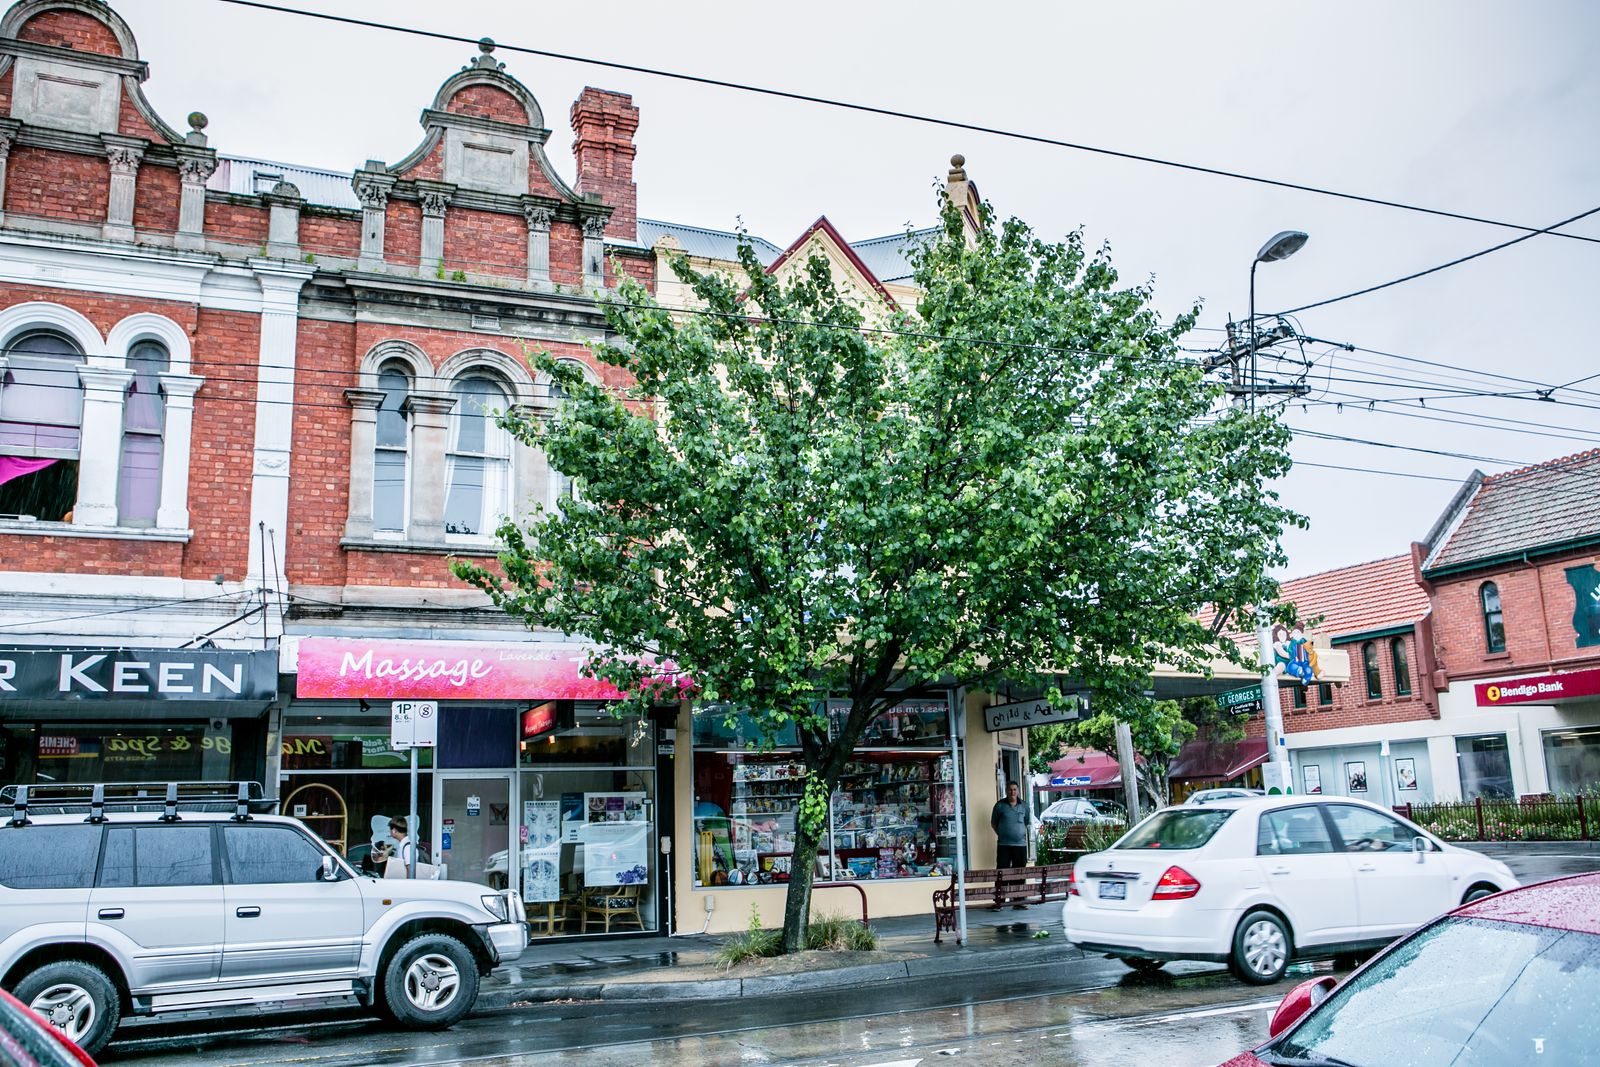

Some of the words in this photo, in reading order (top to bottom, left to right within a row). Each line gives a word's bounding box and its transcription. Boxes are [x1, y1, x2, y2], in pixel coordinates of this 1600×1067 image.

[59, 654, 243, 694] KEEN
[339, 649, 493, 687] Massage
[1500, 685, 1538, 697] Bendigo
[1538, 681, 1564, 693] Bank
[1218, 697, 1226, 706] ST
[1228, 691, 1255, 703] GEORGES
[396, 703, 412, 713] 1P
[993, 708, 1020, 727] Child
[1023, 711, 1031, 720] &
